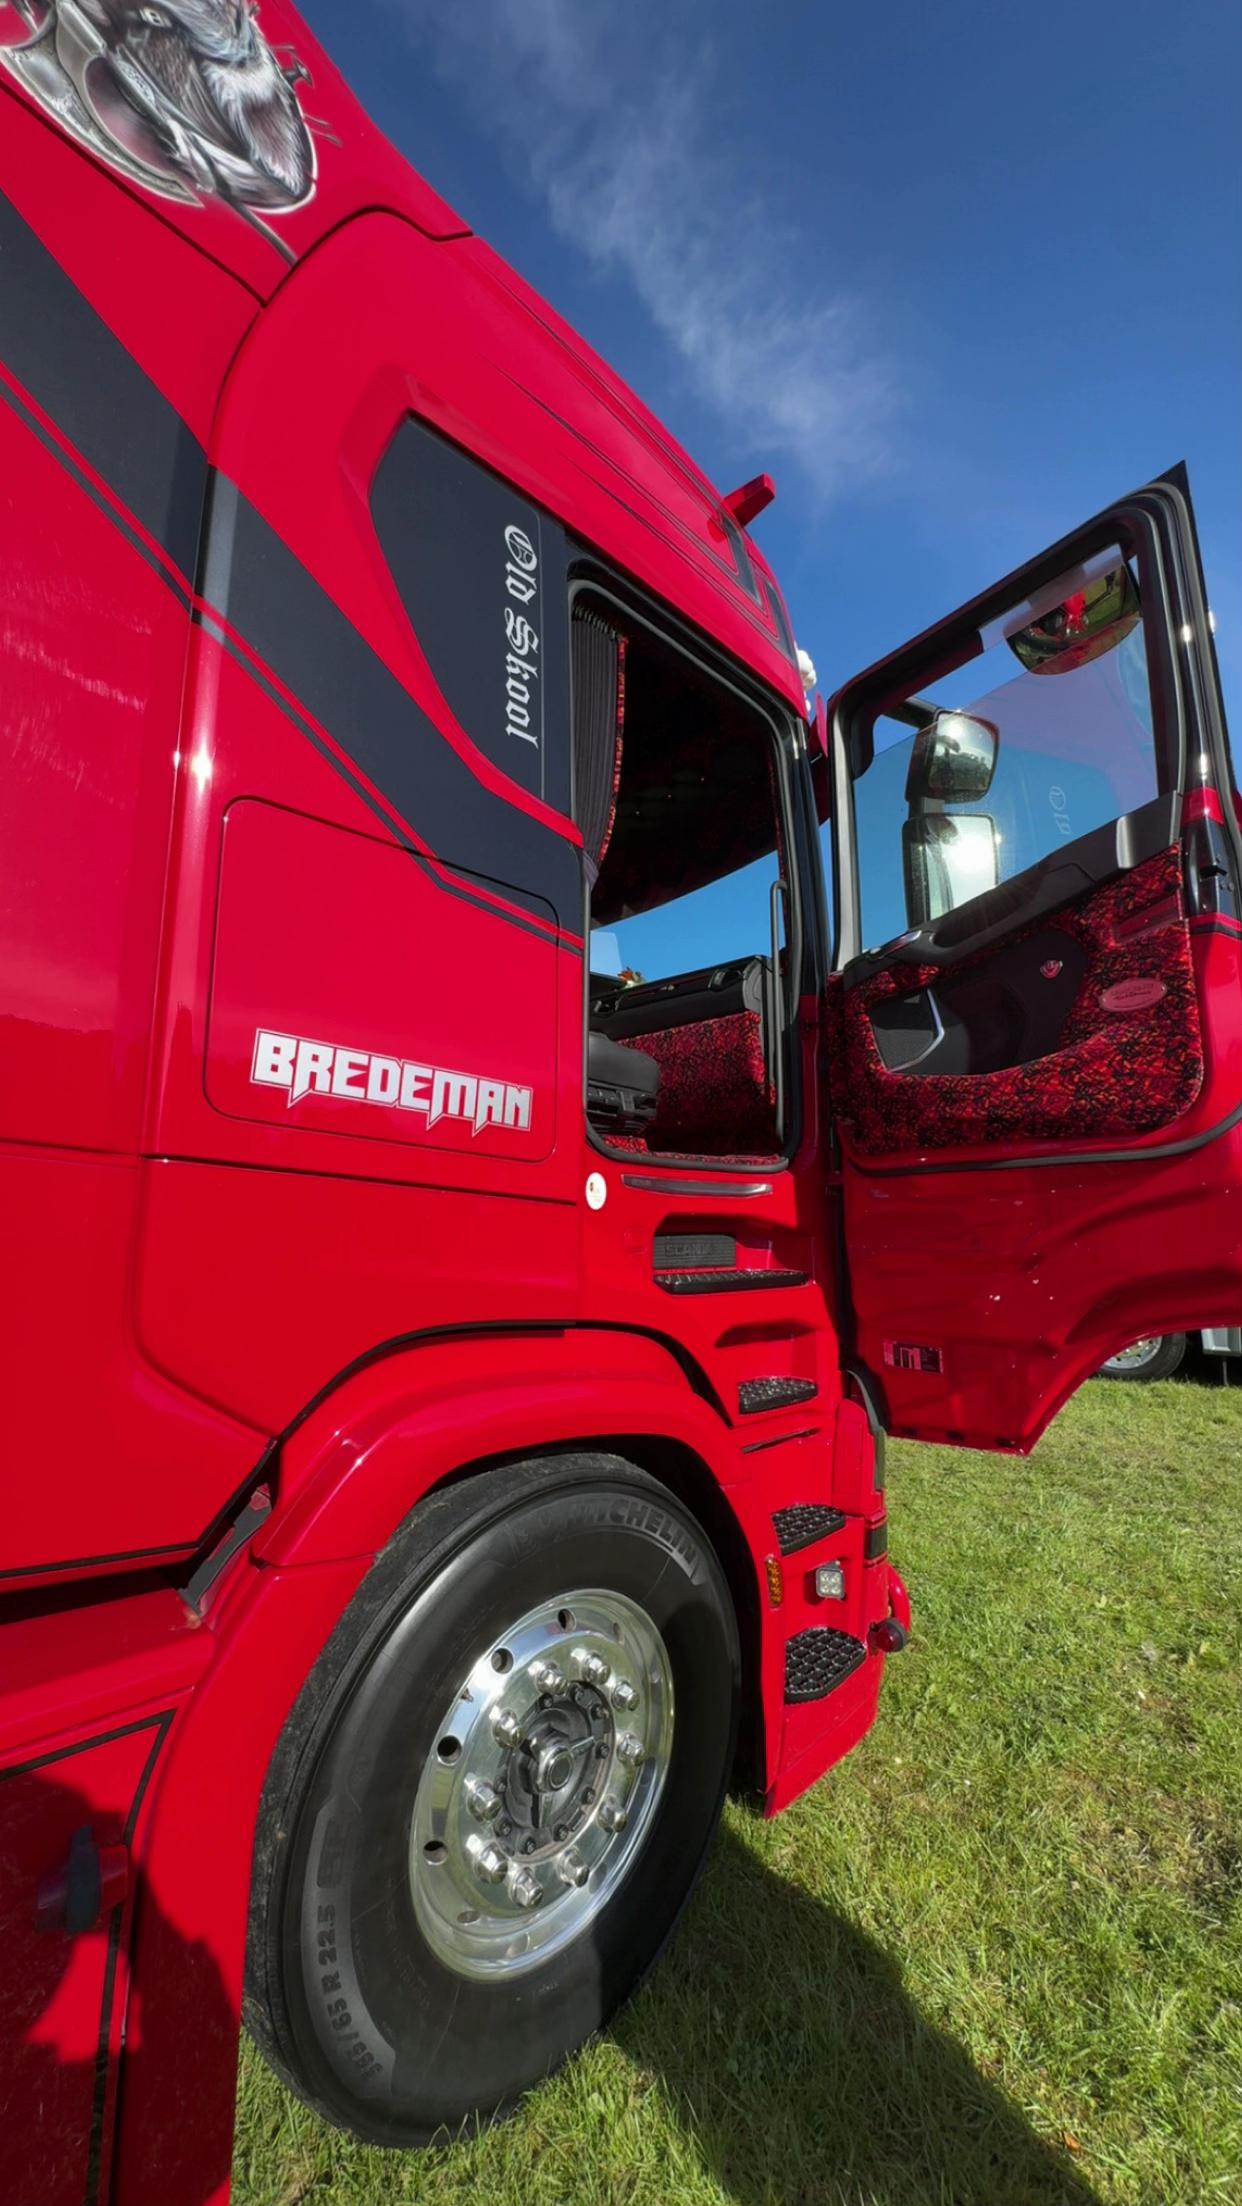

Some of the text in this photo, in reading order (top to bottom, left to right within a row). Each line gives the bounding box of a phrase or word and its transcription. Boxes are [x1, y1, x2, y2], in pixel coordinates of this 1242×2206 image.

[504, 525, 539, 749] Old Skool
[250, 1028, 533, 1137] BREDEMAN
[575, 1498, 698, 1564] ICHELIN
[316, 1904, 338, 1966] 22.5
